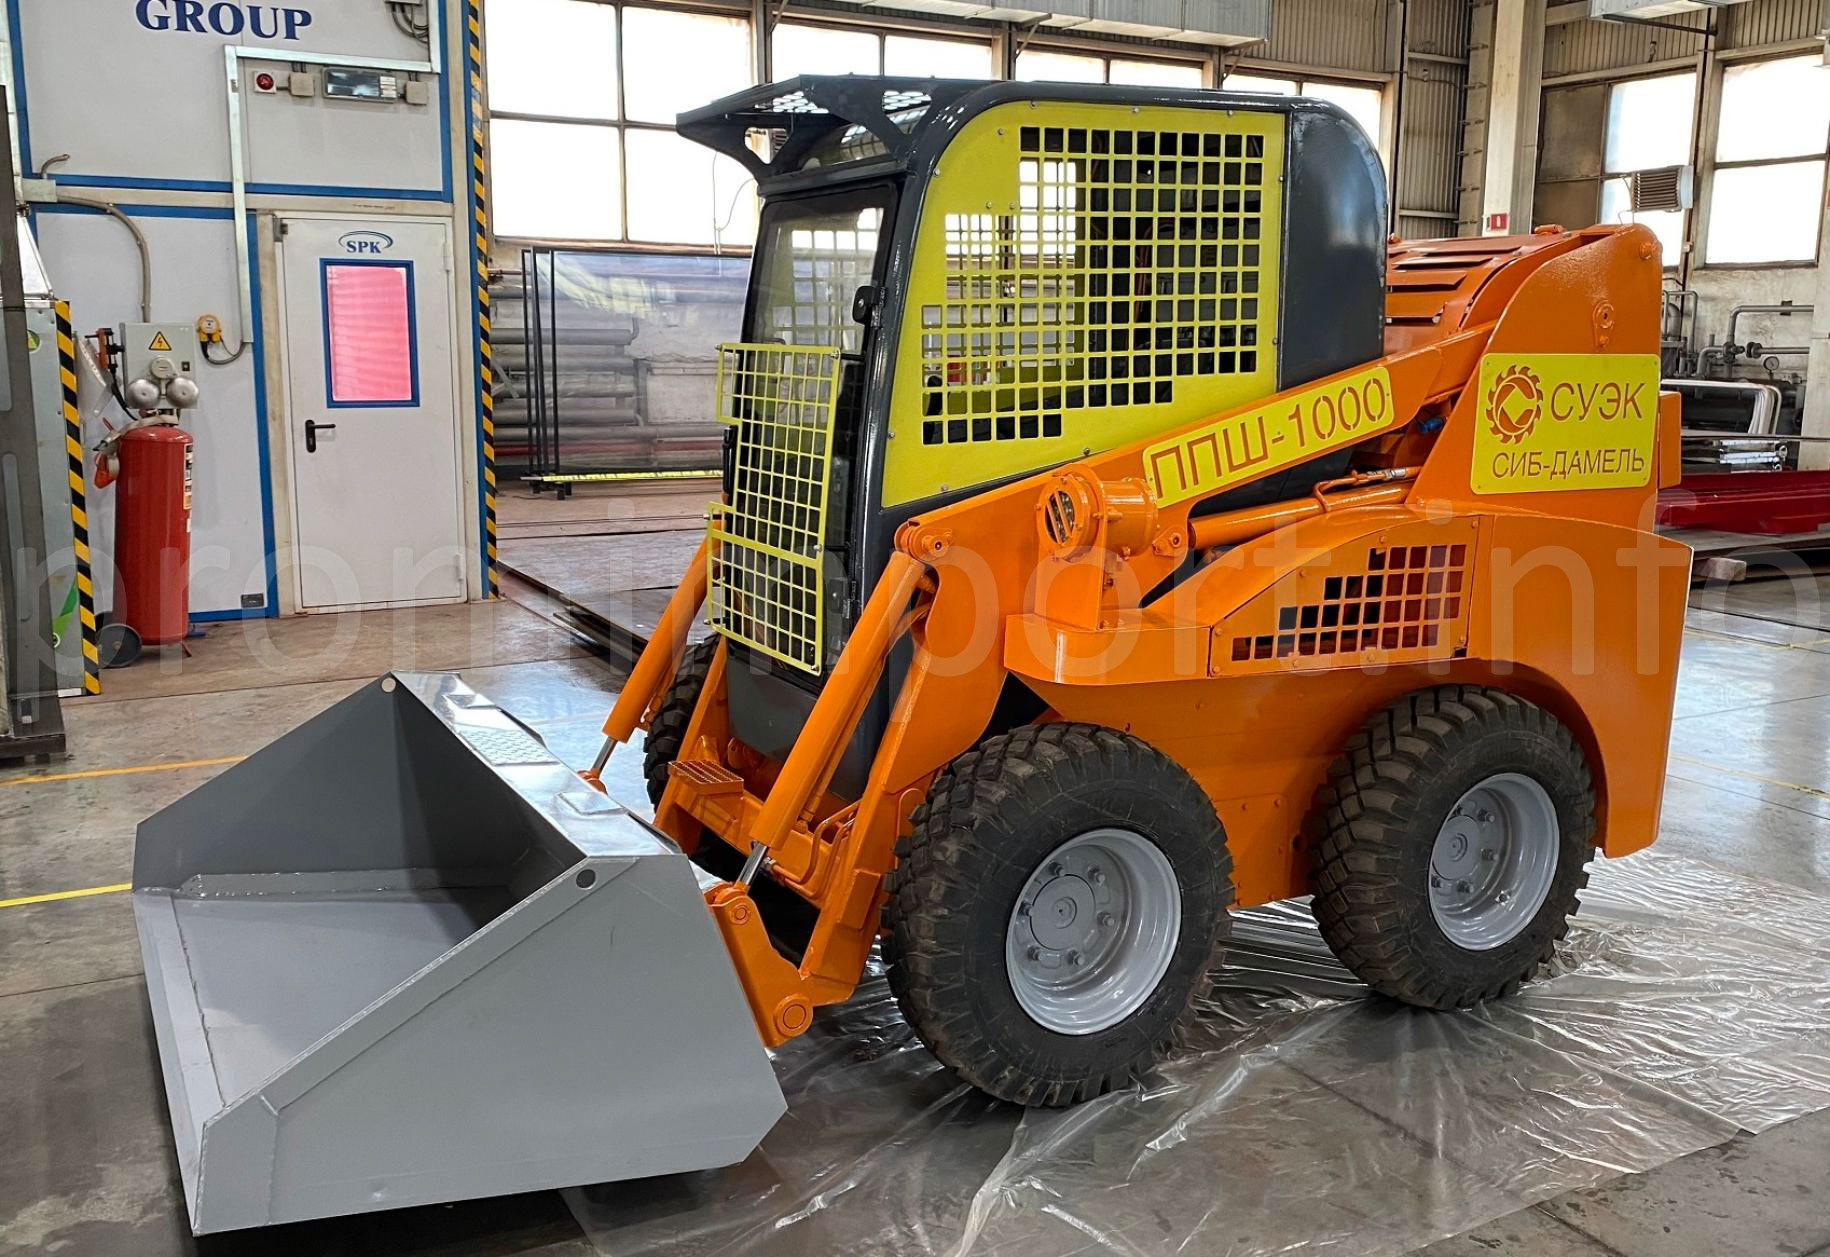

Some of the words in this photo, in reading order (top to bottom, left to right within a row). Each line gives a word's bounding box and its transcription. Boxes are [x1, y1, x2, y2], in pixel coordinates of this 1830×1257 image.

[135, 0, 312, 40] GROUP
[346, 240, 381, 253] SPK
[1550, 382, 1646, 421] СУЭК
[1150, 377, 1386, 499] ППШ-1000
[1491, 448, 1645, 480] СИБ-ДАМЕЛЬ
